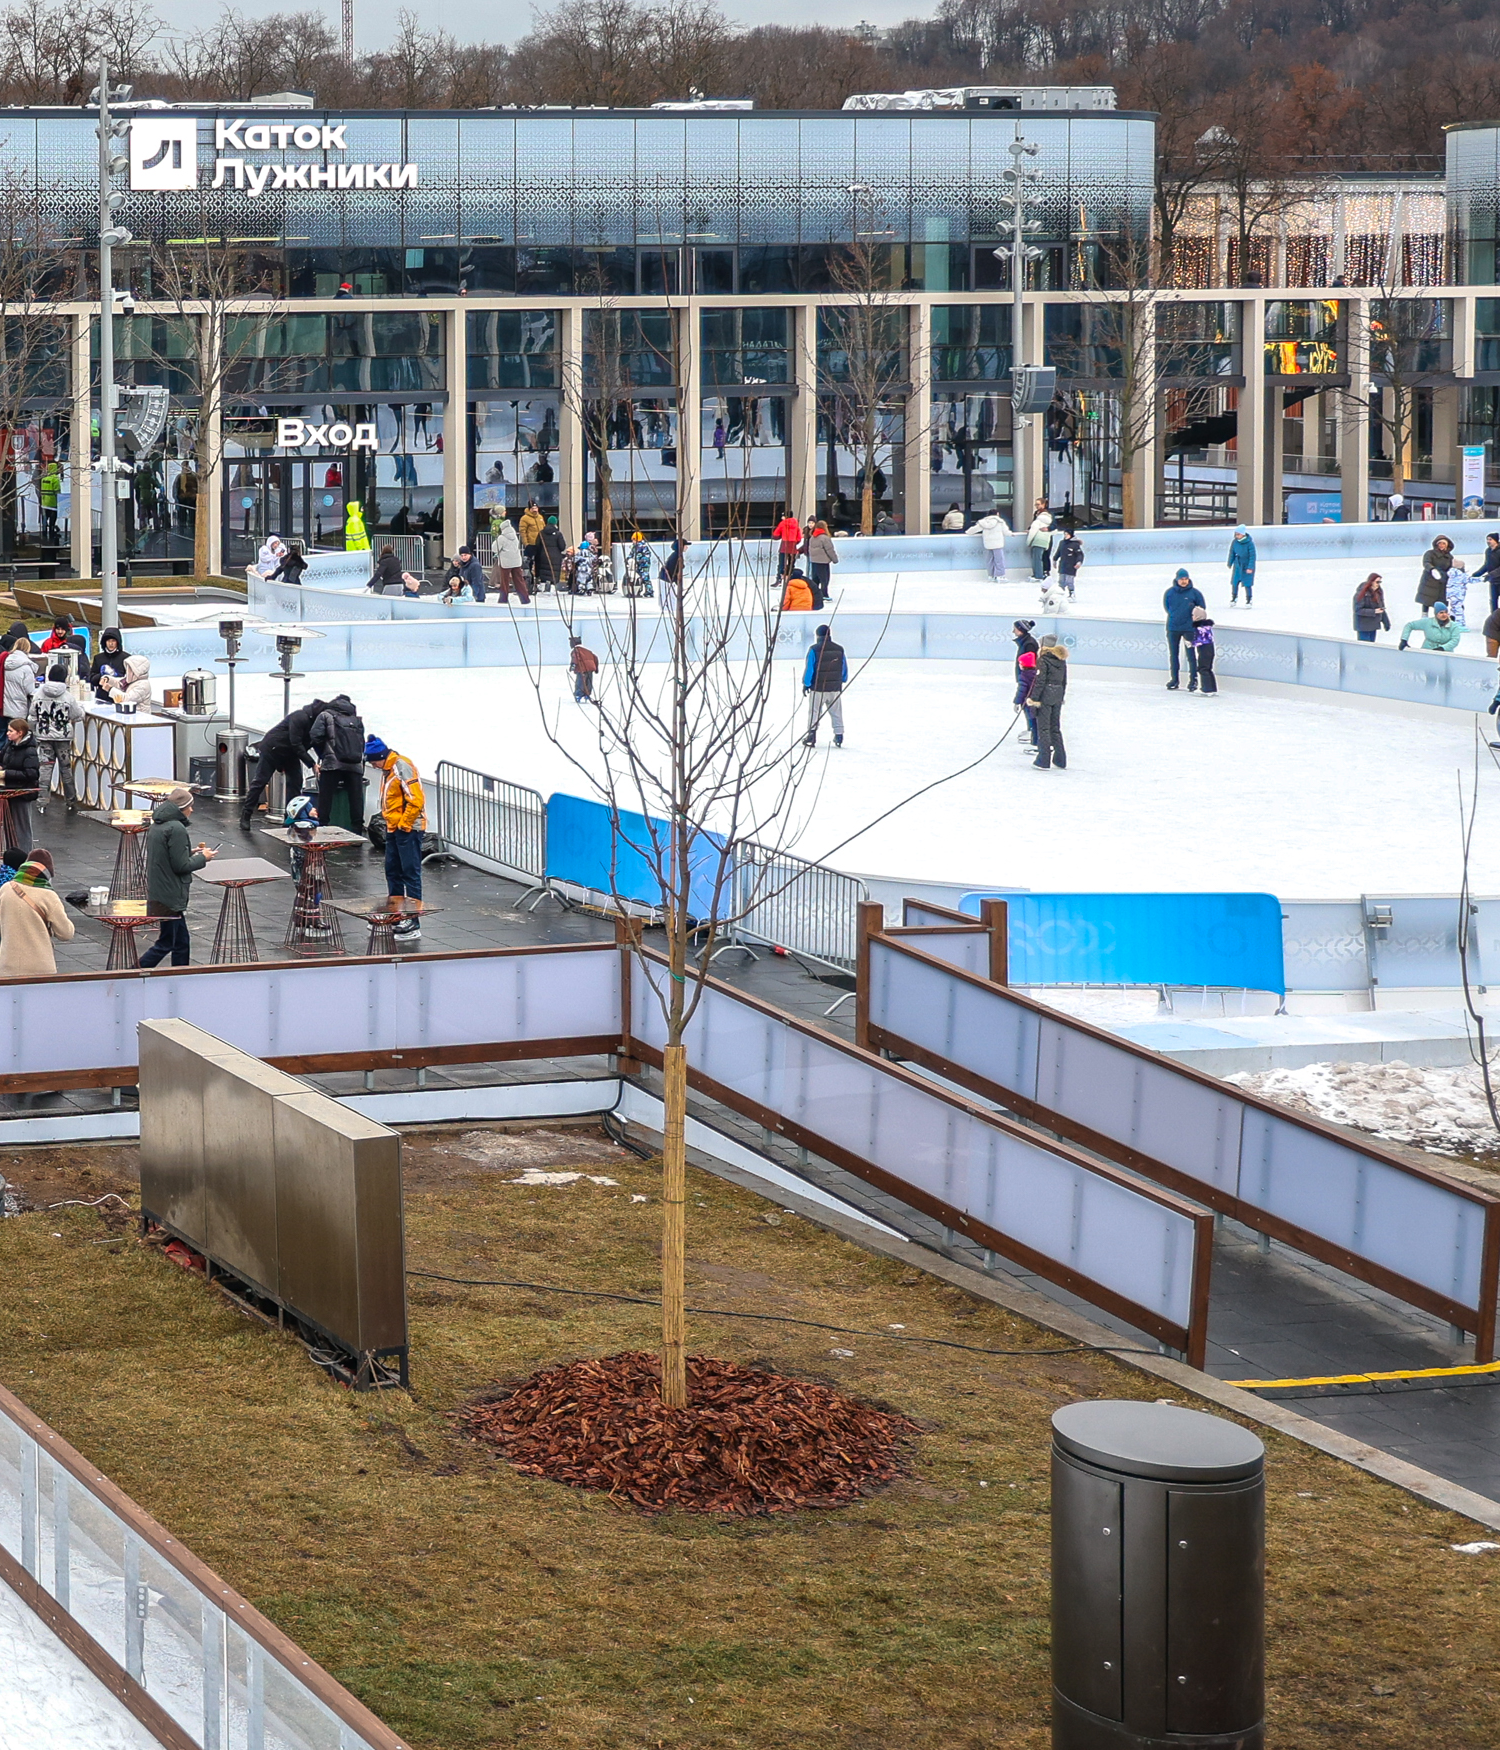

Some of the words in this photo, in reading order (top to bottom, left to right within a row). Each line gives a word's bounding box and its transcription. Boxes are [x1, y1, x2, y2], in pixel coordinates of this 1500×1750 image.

[215, 119, 347, 149] Каток
[211, 158, 418, 197] Лужники
[277, 418, 379, 450] Вход
